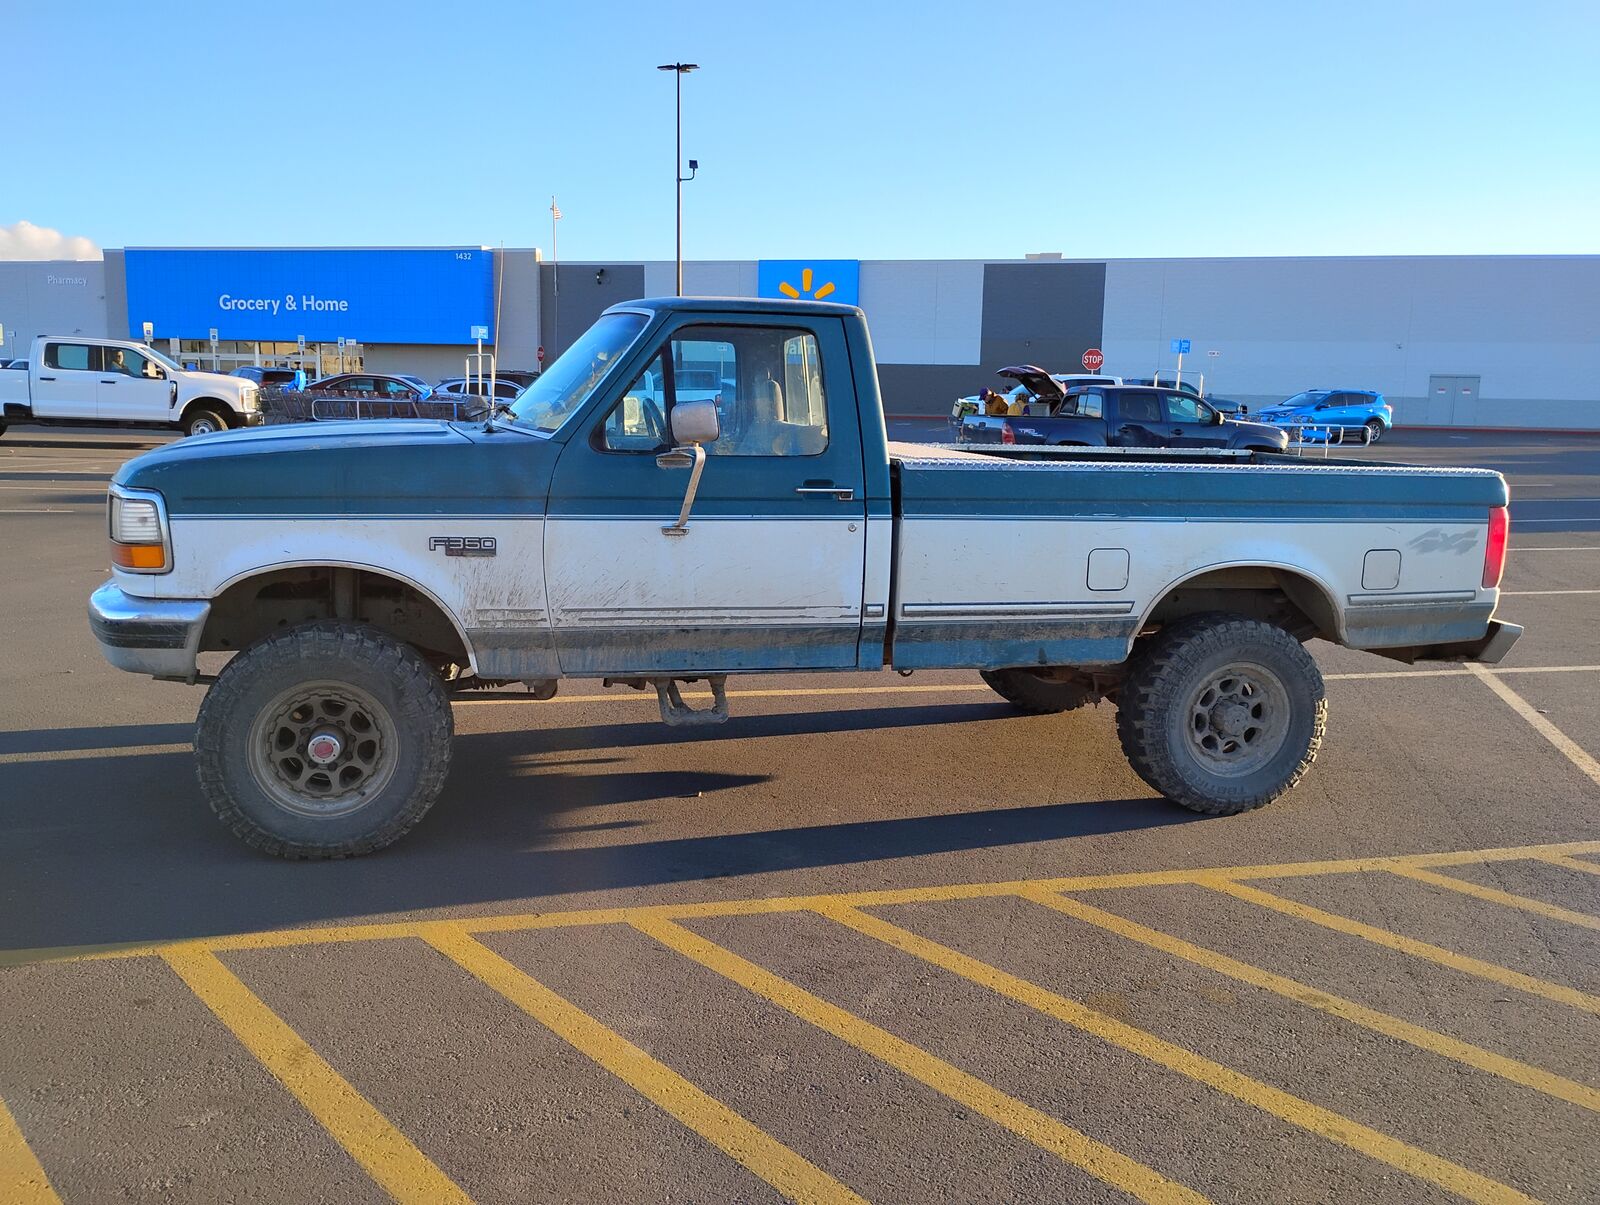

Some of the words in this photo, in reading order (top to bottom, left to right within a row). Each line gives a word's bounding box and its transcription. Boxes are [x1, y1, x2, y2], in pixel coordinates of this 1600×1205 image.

[455, 252, 472, 260] 1432
[47, 275, 88, 287] Pharmacy
[219, 294, 280, 316] Grocery
[285, 294, 297, 311] &
[302, 295, 348, 311] Home
[1083, 355, 1103, 364] STOP
[429, 536, 497, 552] F350
